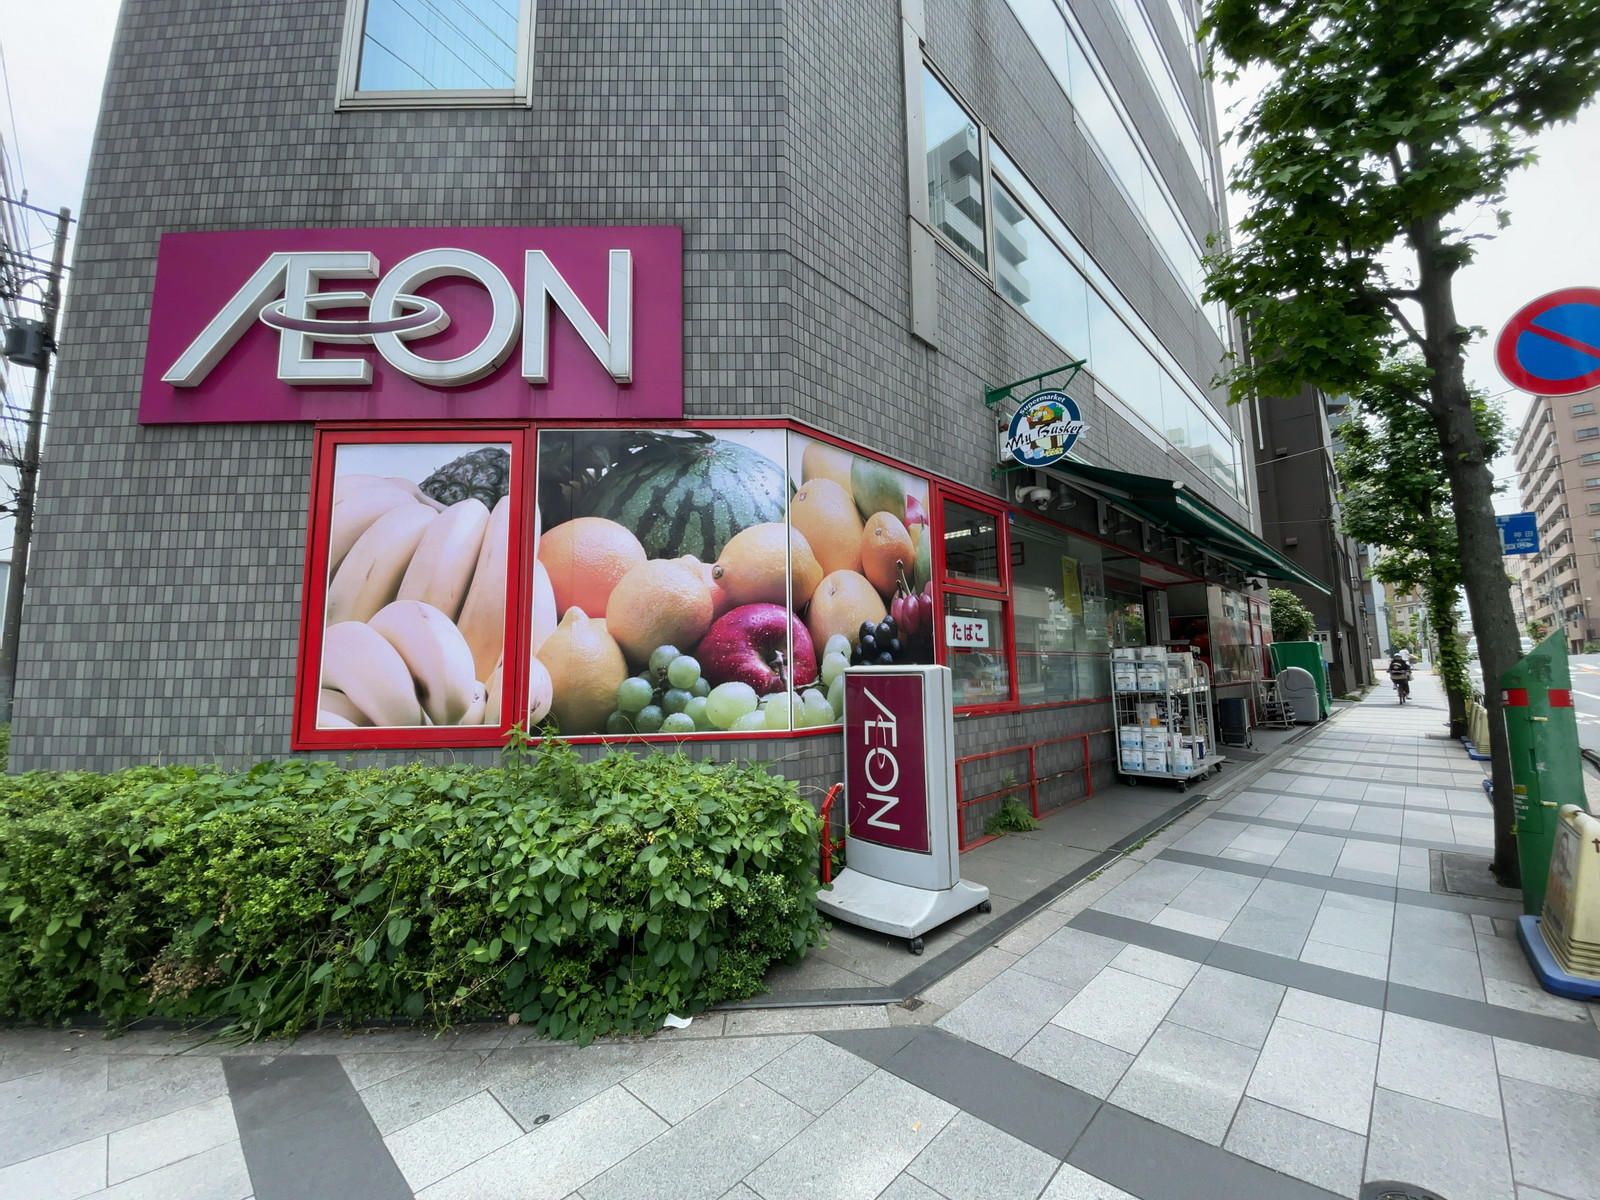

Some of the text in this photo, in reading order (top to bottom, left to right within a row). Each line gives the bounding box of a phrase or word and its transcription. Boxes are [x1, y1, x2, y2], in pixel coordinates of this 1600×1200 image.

[1006, 421, 1084, 451] My Basket
[951, 622, 984, 642] たばこ
